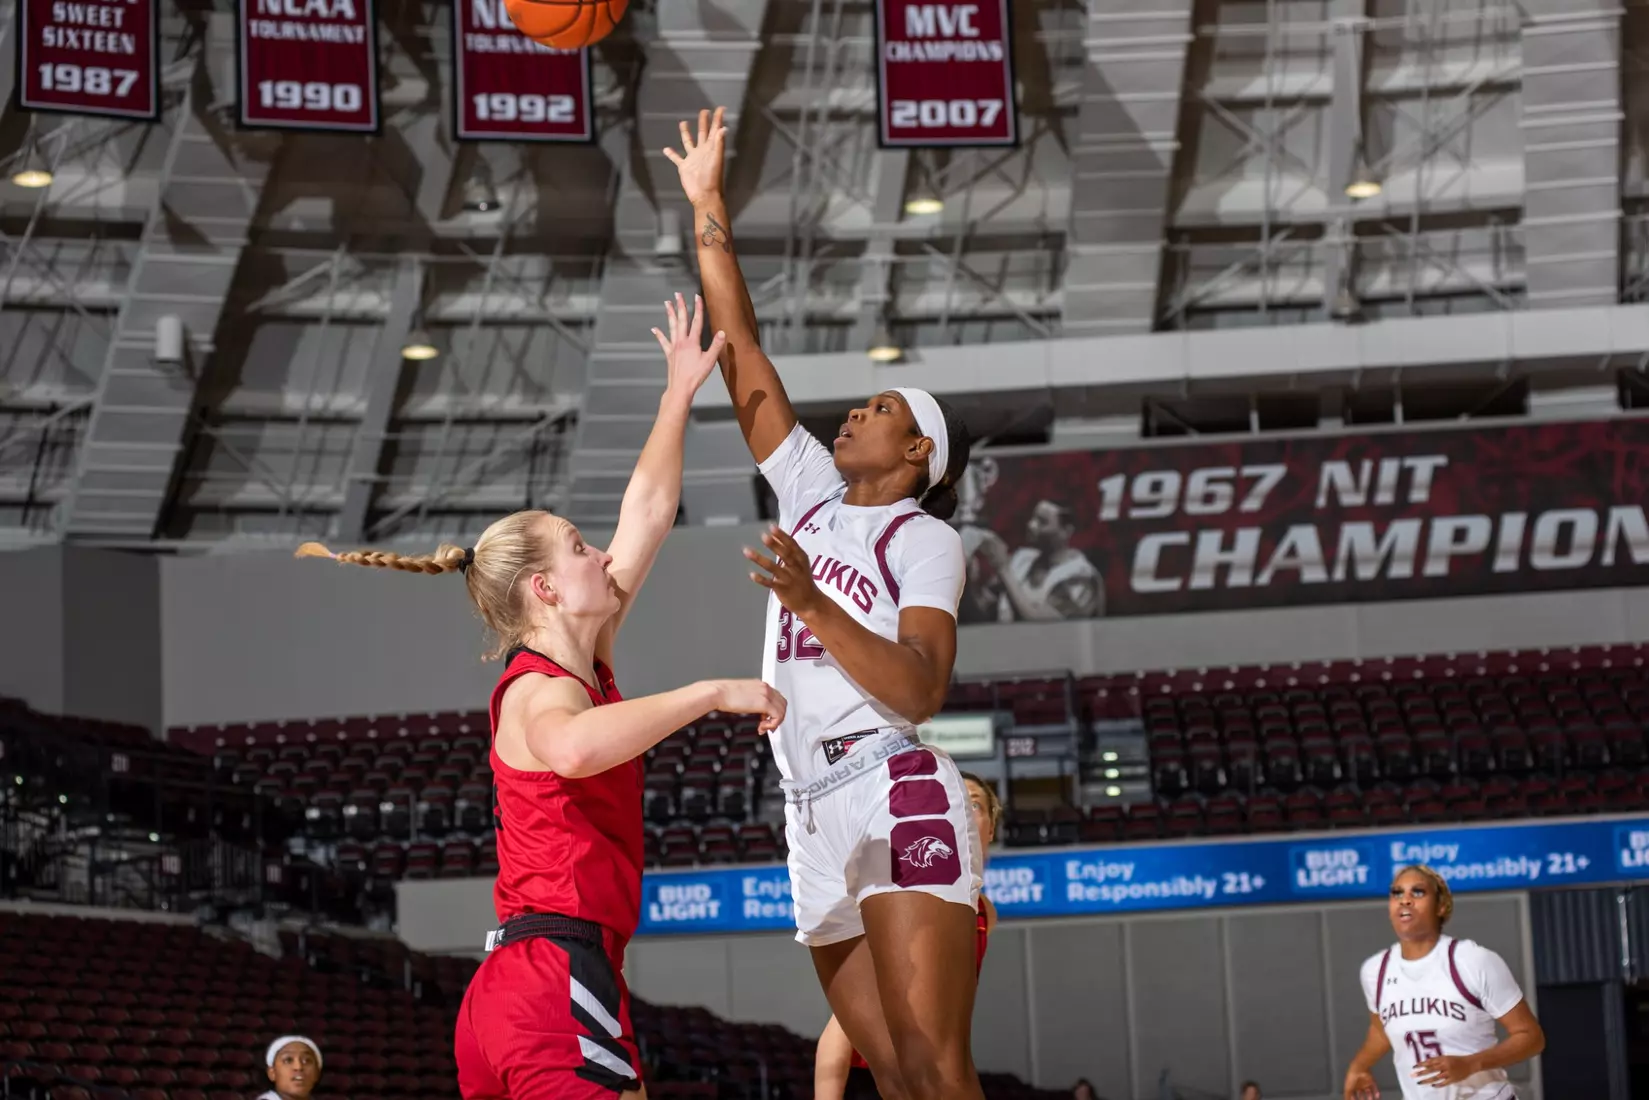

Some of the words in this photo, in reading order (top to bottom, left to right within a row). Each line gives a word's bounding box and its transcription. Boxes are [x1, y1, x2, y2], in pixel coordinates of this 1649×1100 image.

[53, 2, 125, 28] SWEET
[905, 4, 980, 37] MVC
[42, 25, 136, 55] SIXTEEN
[249, 19, 365, 44] TOURNAMENT
[886, 40, 1004, 62] CHAMPIONS
[38, 62, 139, 97] 1987
[258, 80, 362, 113] 1990
[473, 93, 576, 123] 1992
[890, 99, 1003, 128] 2007
[1097, 462, 1288, 521] 1967
[1315, 454, 1449, 509] NIT
[810, 554, 879, 615] UKIS
[776, 604, 827, 664] 32
[1305, 849, 1360, 870] BUD
[1390, 840, 1459, 864] Enjoy
[1547, 852, 1591, 875] 21+
[984, 867, 1035, 887] BUD
[1065, 860, 1134, 883] Enjoy
[1296, 864, 1369, 888] LIGHT
[657, 883, 712, 905] BUD
[984, 883, 1043, 904] IGHT
[1066, 875, 1217, 903] Responsibly
[1221, 872, 1266, 895] 21+
[649, 900, 721, 922] LIGHT
[1404, 1028, 1443, 1066] 15
